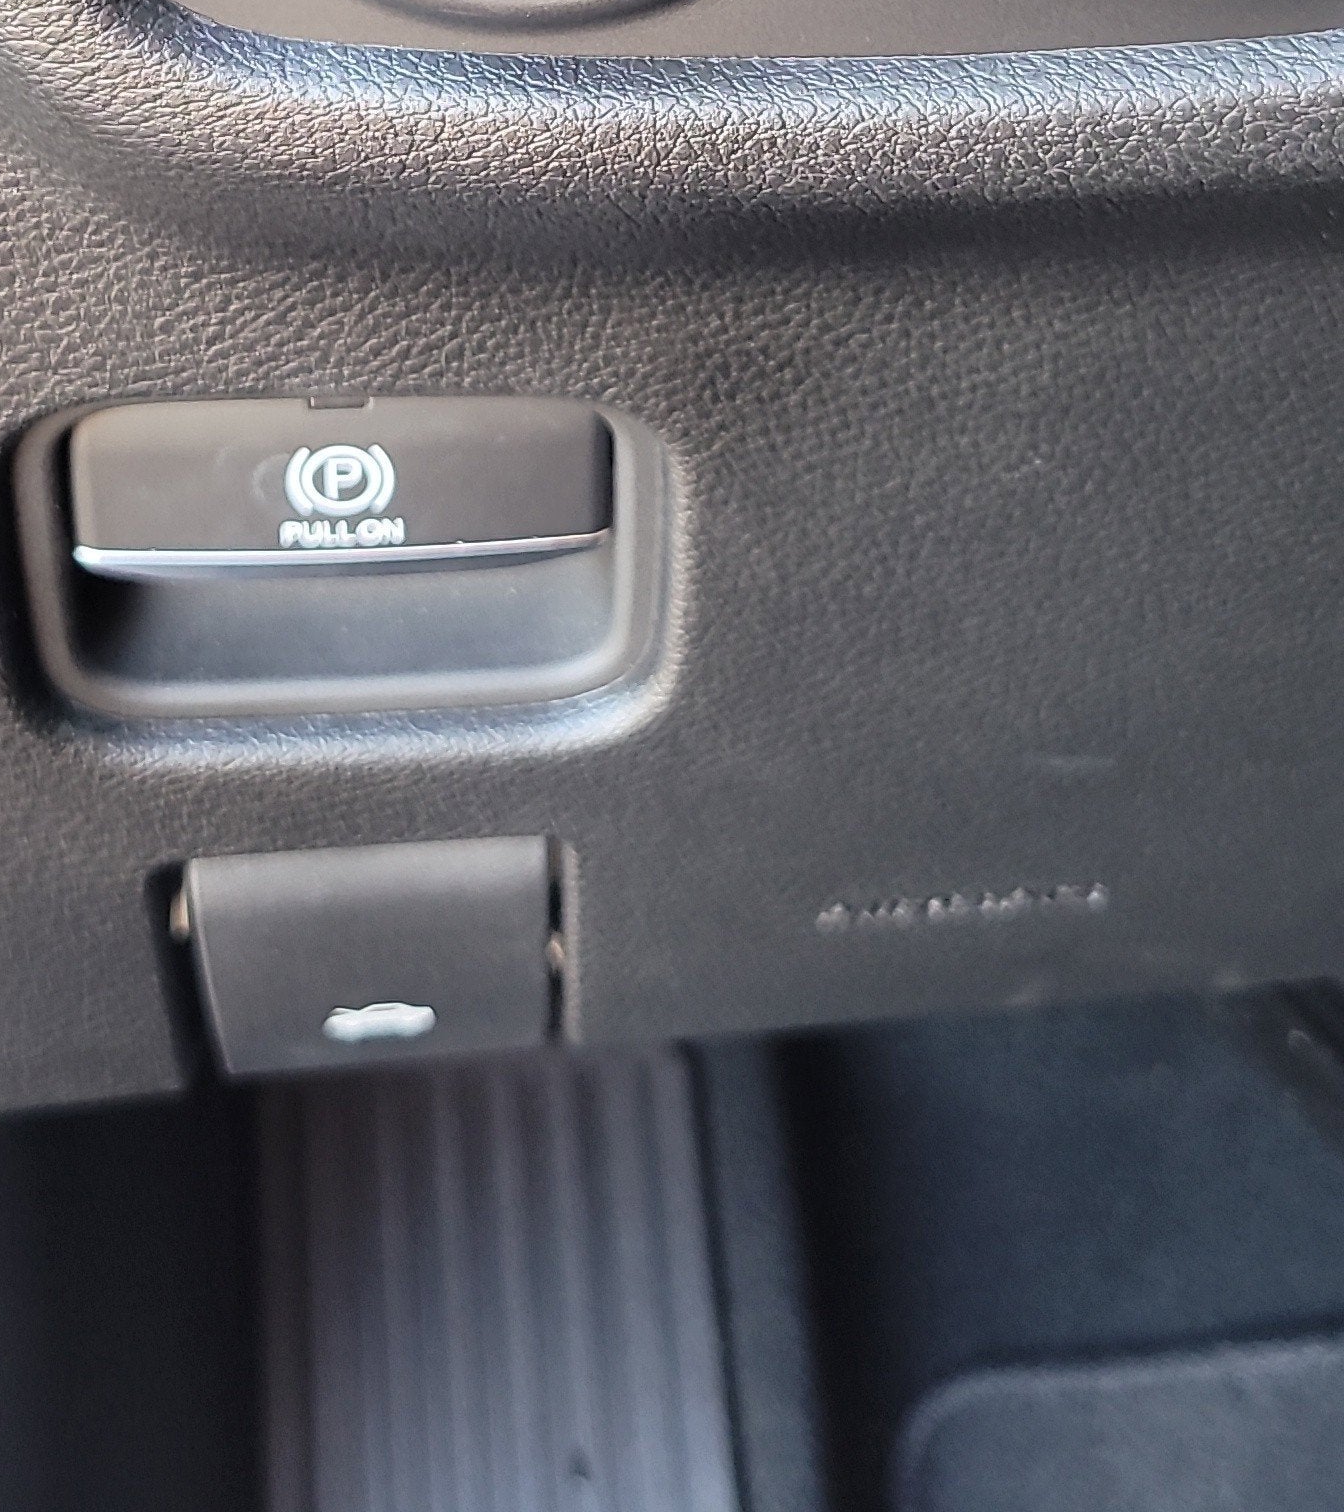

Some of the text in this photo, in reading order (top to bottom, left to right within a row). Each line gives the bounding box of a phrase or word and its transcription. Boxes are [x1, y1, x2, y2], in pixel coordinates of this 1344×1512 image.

[323, 456, 363, 501] P
[278, 517, 405, 548] PULL ON
